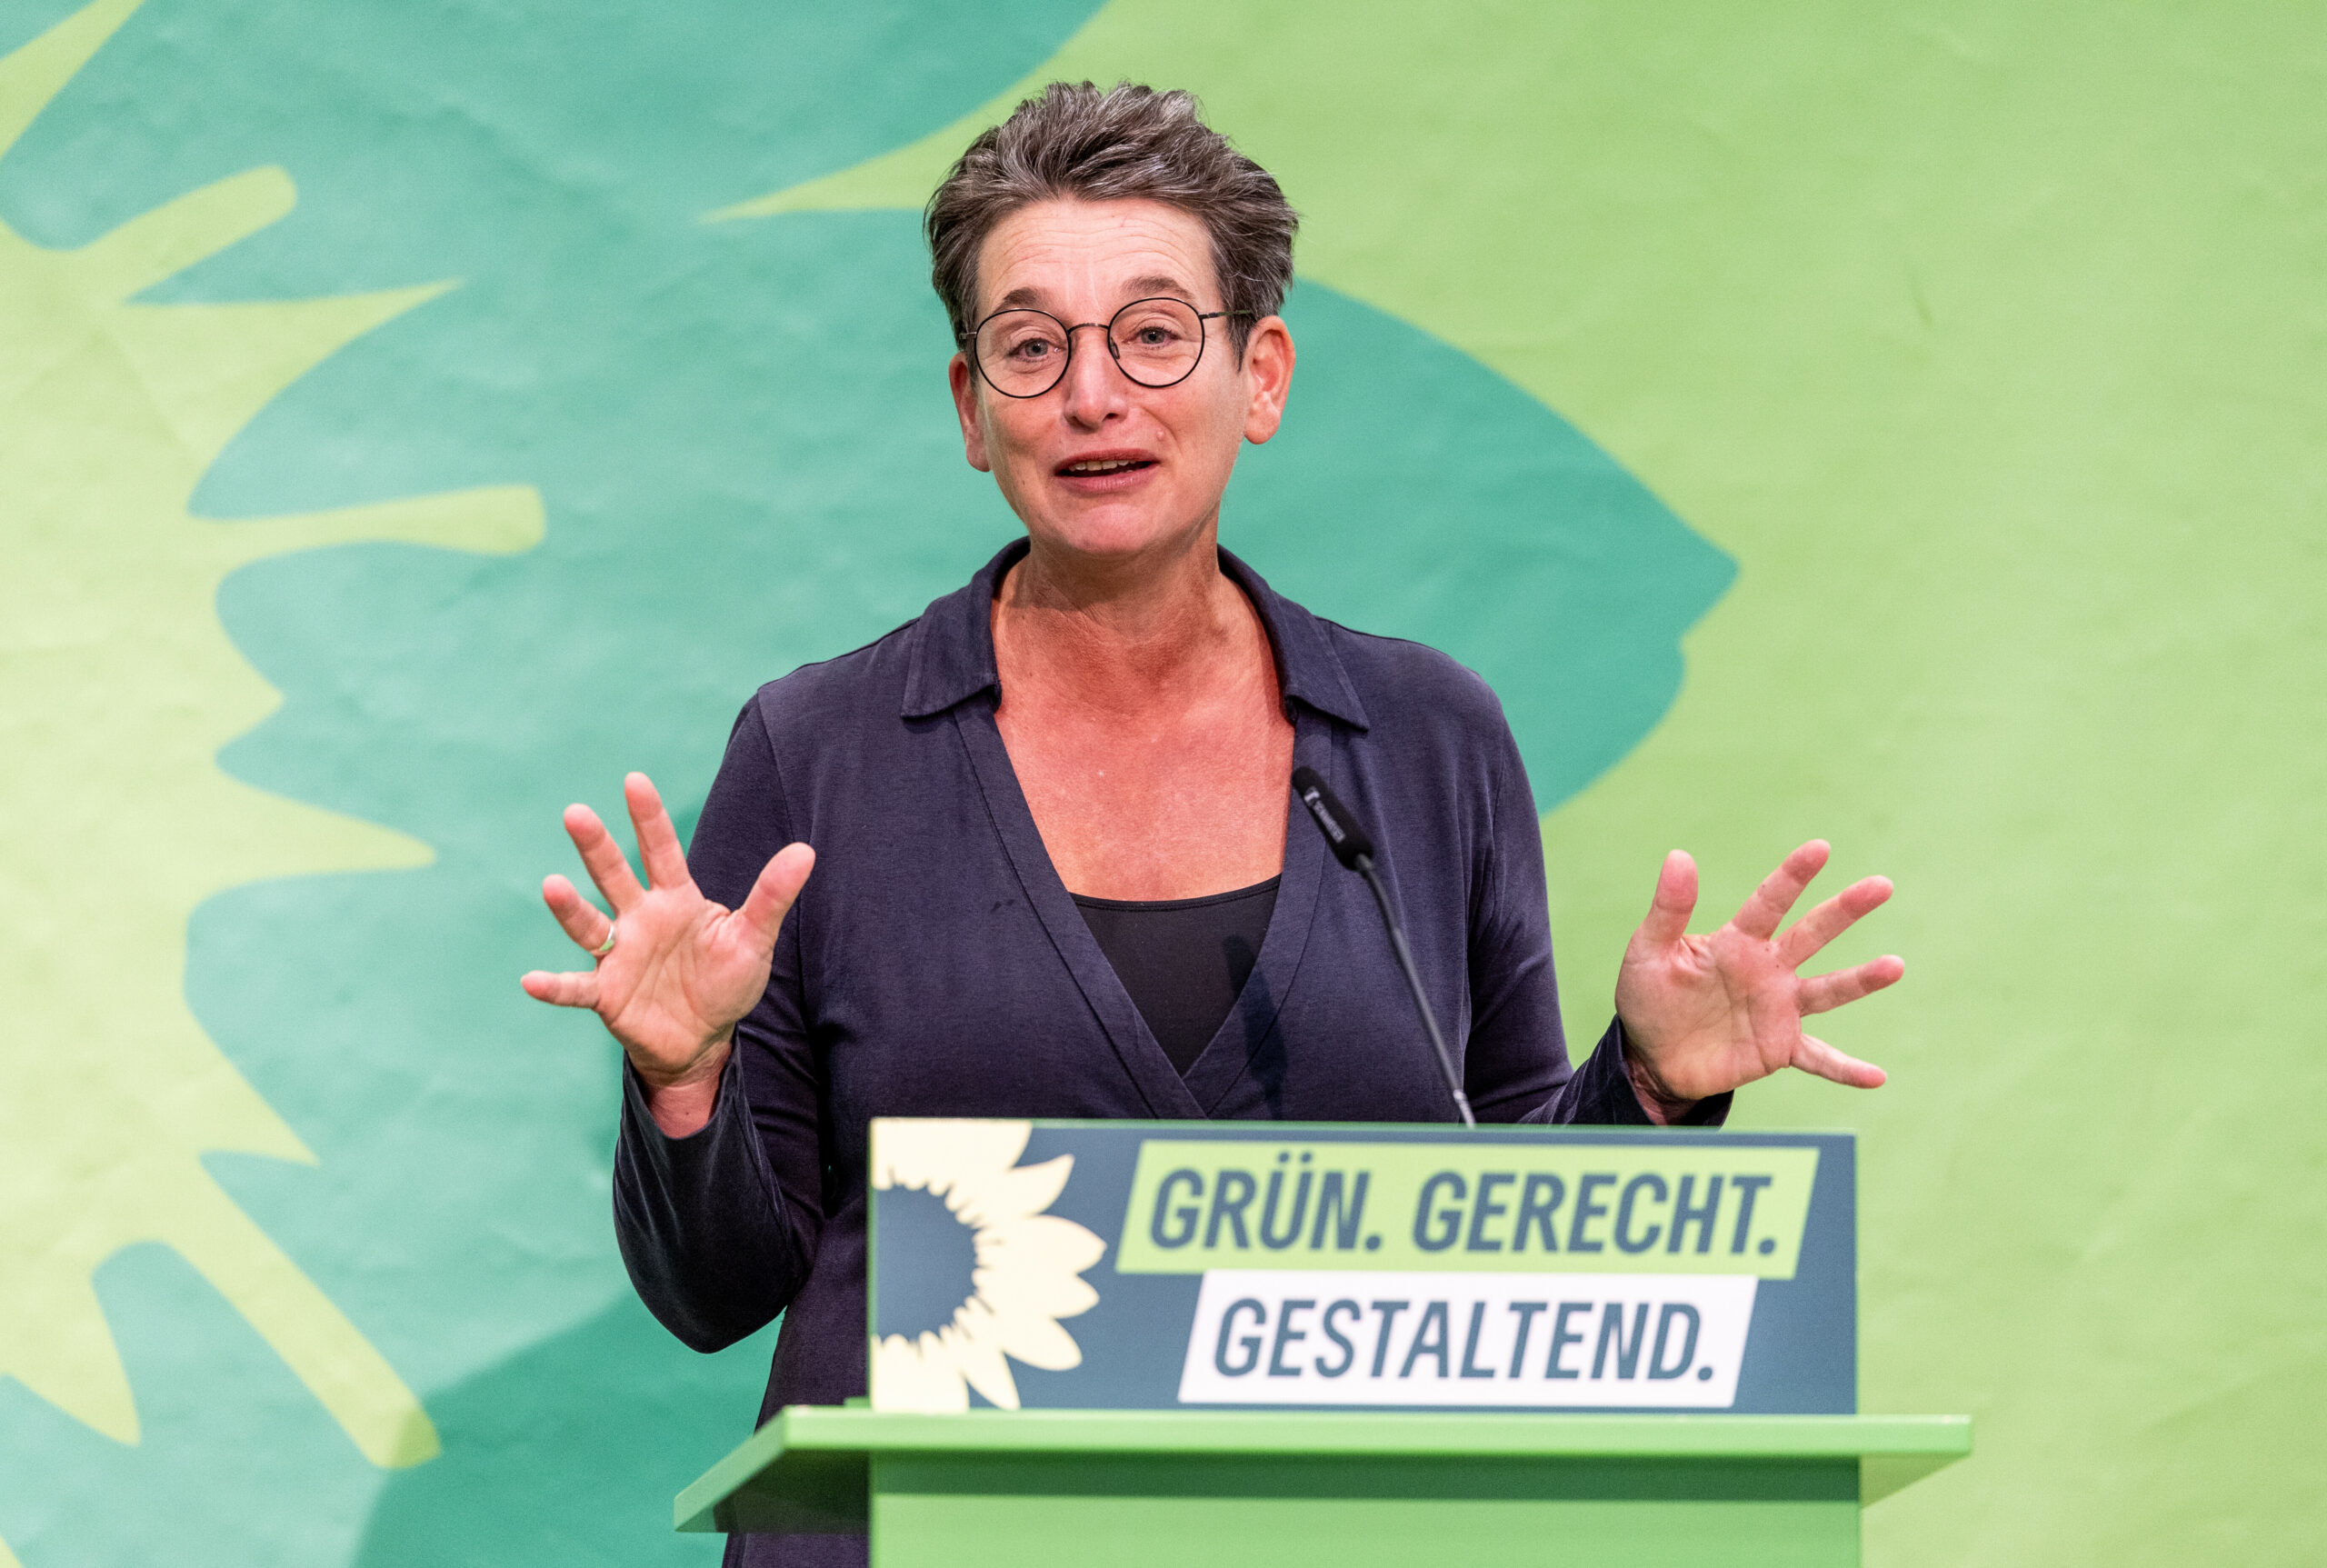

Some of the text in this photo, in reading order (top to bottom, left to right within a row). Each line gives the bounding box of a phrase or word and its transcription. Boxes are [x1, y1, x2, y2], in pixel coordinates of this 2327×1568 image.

[1149, 1150, 1776, 1256] GRÜN. GERECHT.
[1213, 1296, 1714, 1382] GESTALTEND.
